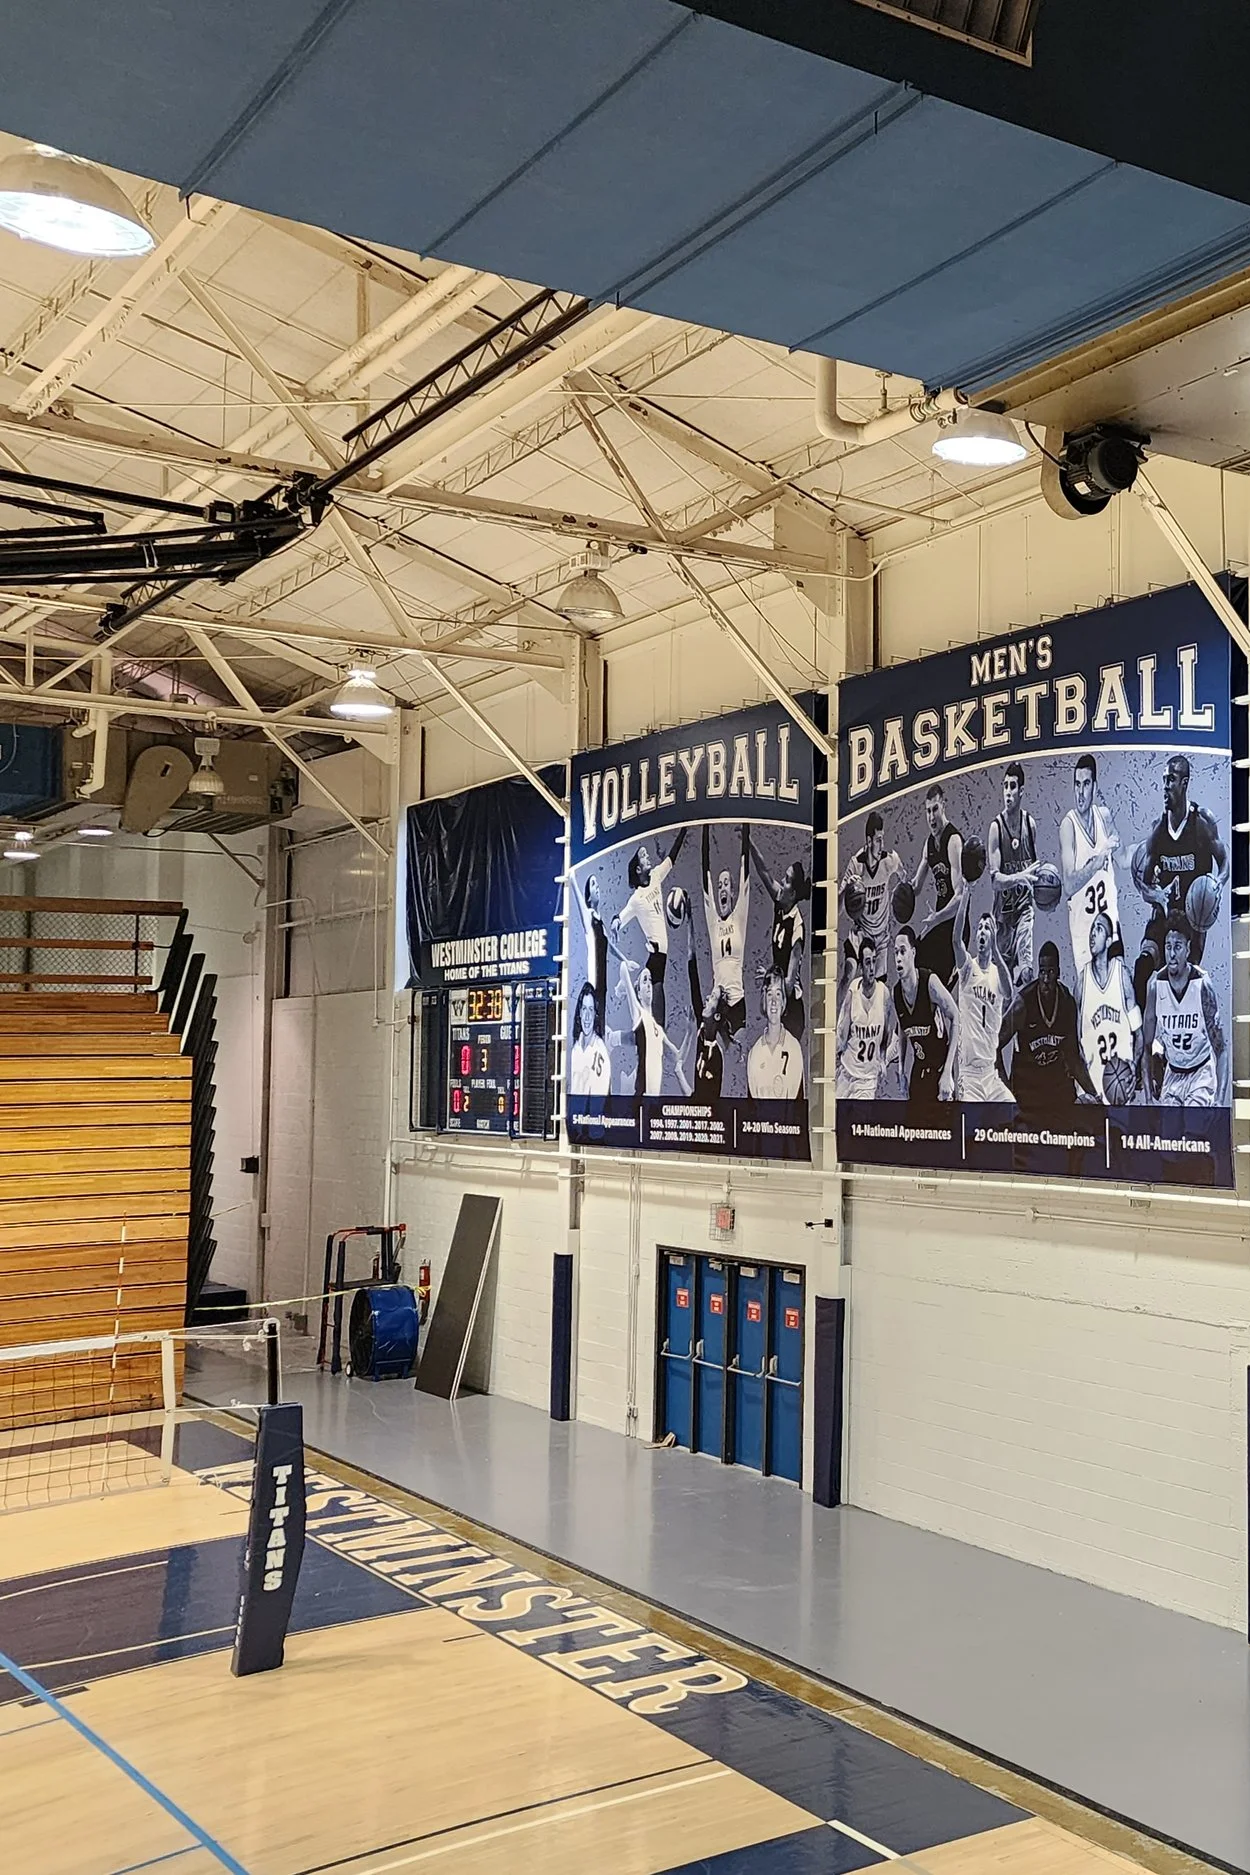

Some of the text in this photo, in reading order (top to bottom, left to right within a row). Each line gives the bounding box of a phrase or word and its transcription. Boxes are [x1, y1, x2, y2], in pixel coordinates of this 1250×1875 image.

[970, 634, 1053, 687] MEN'S
[848, 642, 1215, 801] BASKETBALL
[580, 722, 800, 844] VOLLEYBALL
[1085, 880, 1108, 914] 32
[431, 929, 548, 968] WESTMINSTER COLLEGE
[444, 961, 530, 981] HOME OF THE TITANS
[1162, 1013, 1199, 1029] TITANS
[500, 1025, 519, 1040] GUET
[858, 1040, 875, 1062] 20
[781, 1051, 789, 1075] 7
[601, 1115, 635, 1128] Appearances
[662, 1105, 712, 1117] CHAMPIONSHIPS
[761, 1121, 773, 1133] Win
[774, 1122, 800, 1135] Seasons
[851, 1124, 952, 1142] 14-National Appearances
[974, 1128, 1095, 1149] 29 Conference Champions
[1121, 1135, 1211, 1153] 14 All-Americans
[262, 1463, 293, 1592] TITANS
